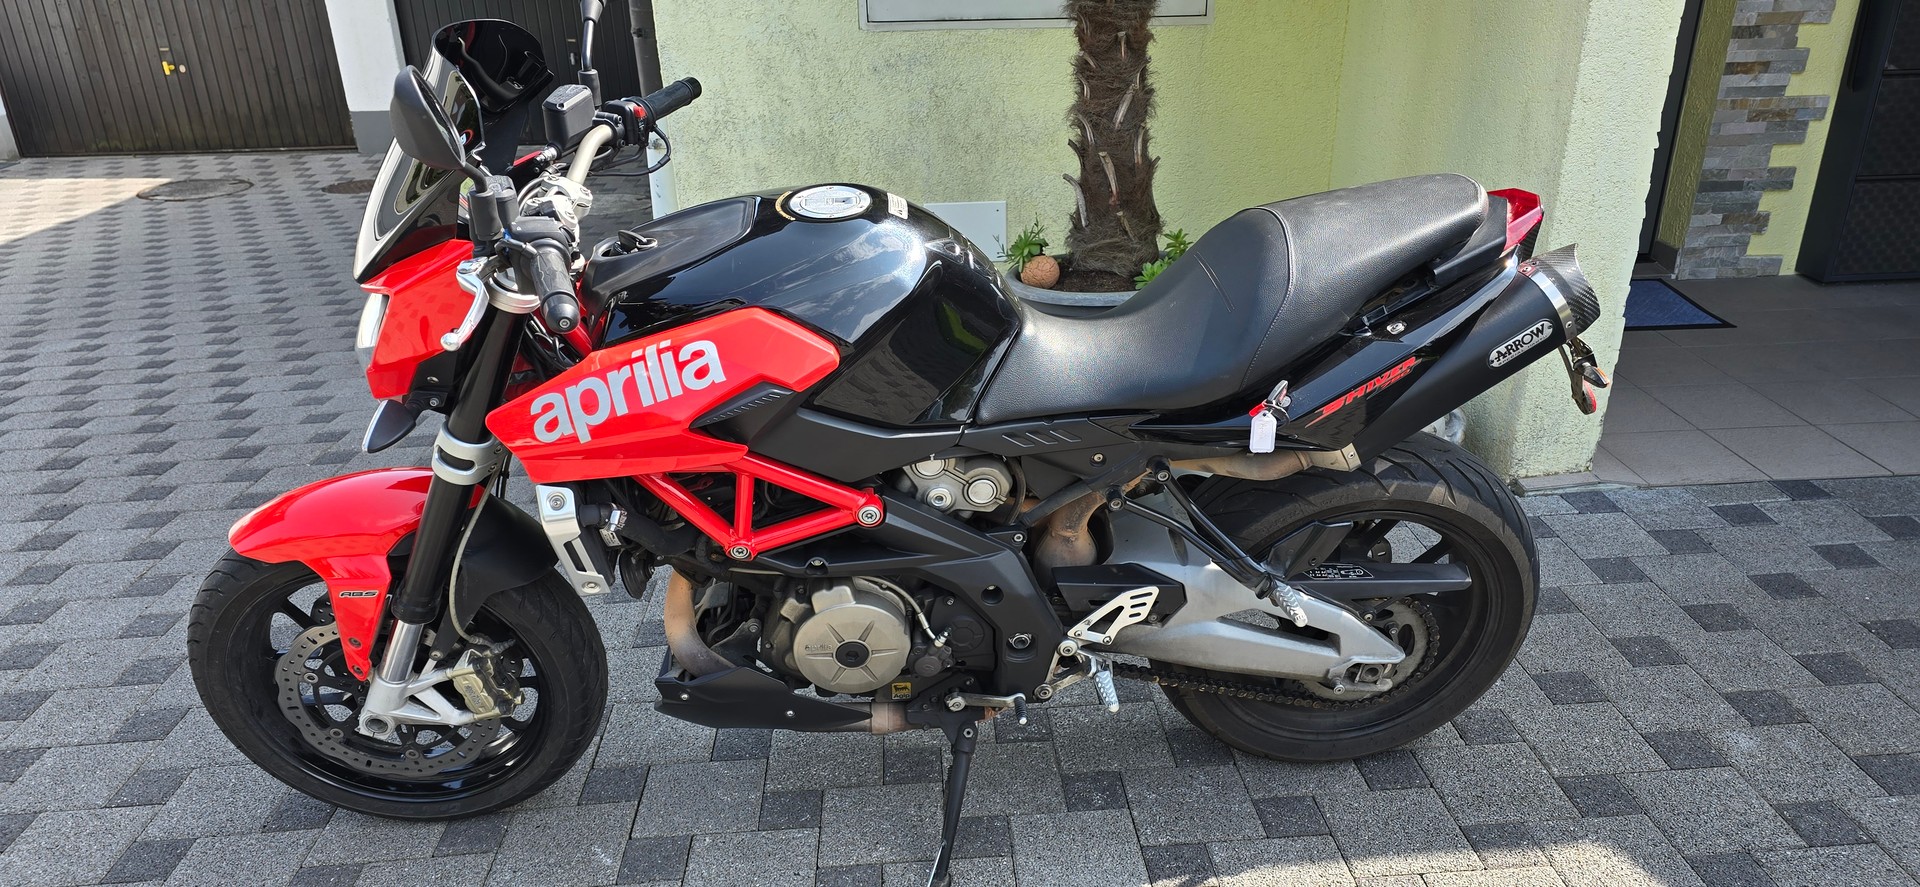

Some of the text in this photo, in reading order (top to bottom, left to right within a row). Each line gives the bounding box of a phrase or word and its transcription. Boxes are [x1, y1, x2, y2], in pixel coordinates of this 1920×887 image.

[1495, 323, 1545, 362] ARROW
[530, 339, 727, 444] aprilia
[1307, 356, 1416, 426] SHIVER
[339, 590, 379, 598] ABS
